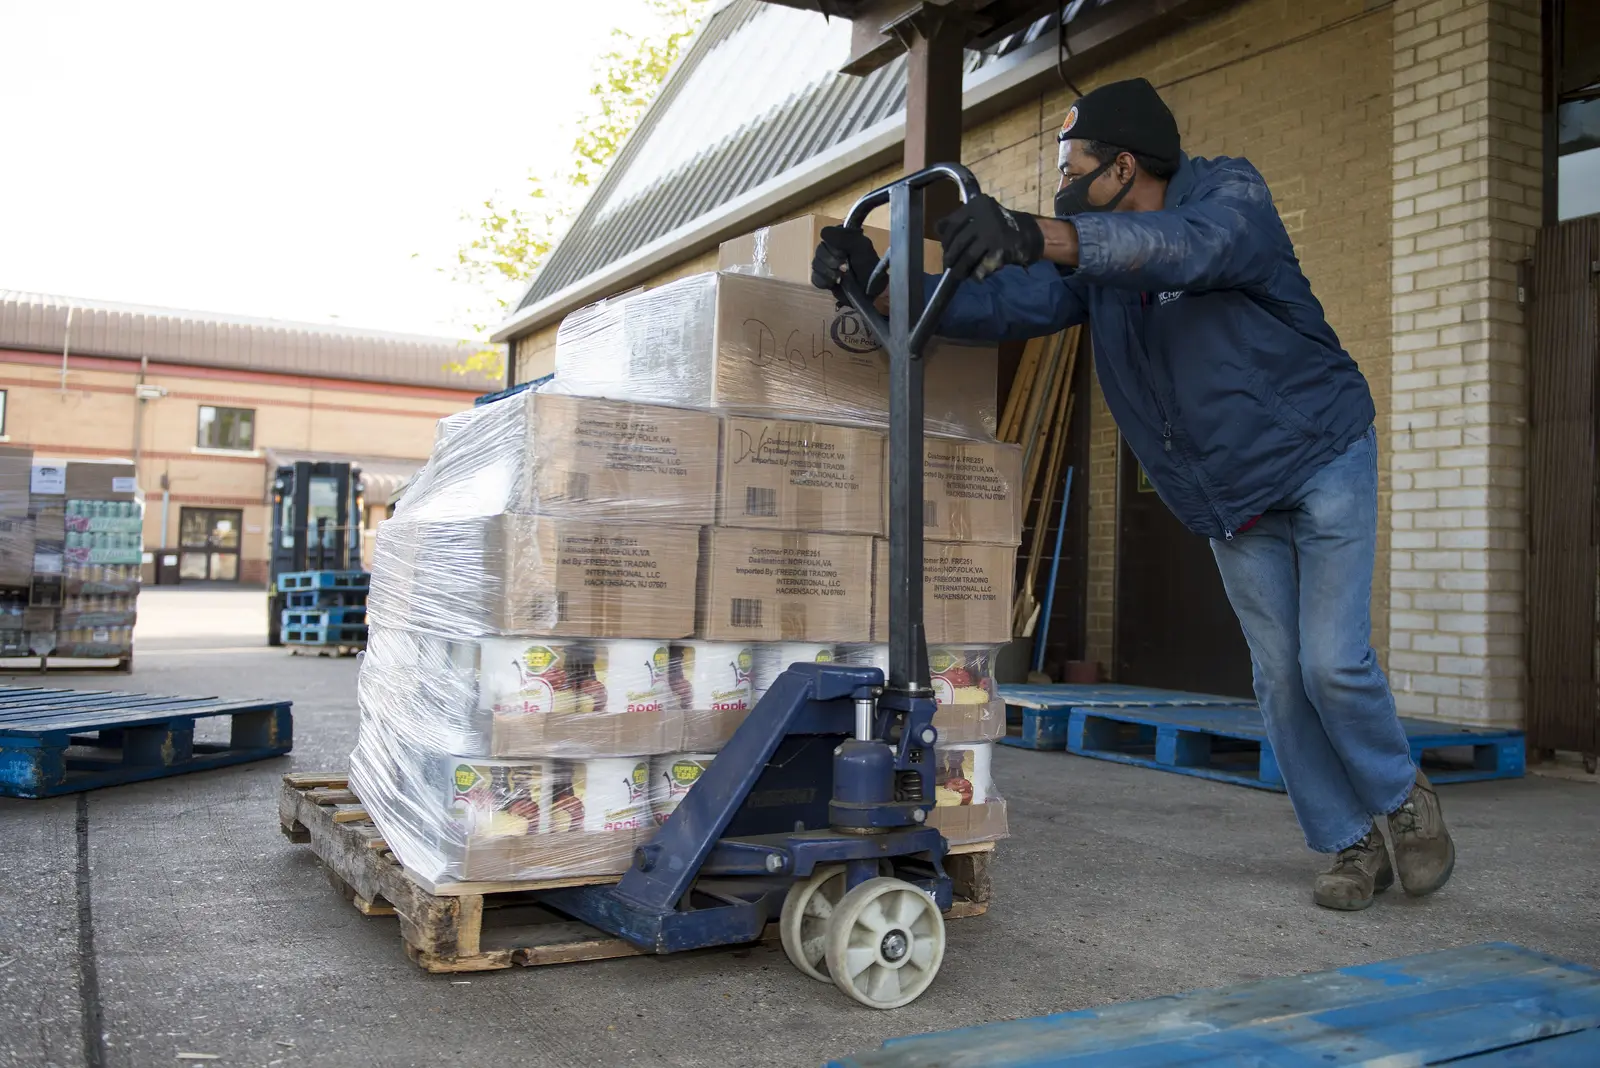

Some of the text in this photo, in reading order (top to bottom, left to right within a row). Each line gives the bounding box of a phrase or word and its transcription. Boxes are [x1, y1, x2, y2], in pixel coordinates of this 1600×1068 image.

[811, 442, 835, 451] FRE251
[962, 455, 984, 464] FRE251
[835, 481, 843, 489] NJ
[752, 546, 783, 556] Customer
[796, 549, 820, 557] FRE251
[623, 560, 657, 569] TRADING
[646, 571, 661, 579] LLC
[736, 566, 764, 576] Imported
[765, 567, 774, 577] By
[808, 570, 838, 578] TRADING
[776, 578, 841, 588] INTERNATIONAL, LLC
[924, 575, 932, 584] By
[962, 576, 989, 584] TRADING
[648, 581, 667, 589] 07601
[980, 585, 992, 593] LLC
[776, 587, 820, 597] HACKENSACK,
[820, 588, 830, 596] NJ
[712, 699, 748, 711] apple
[676, 772, 697, 780] LEAF
